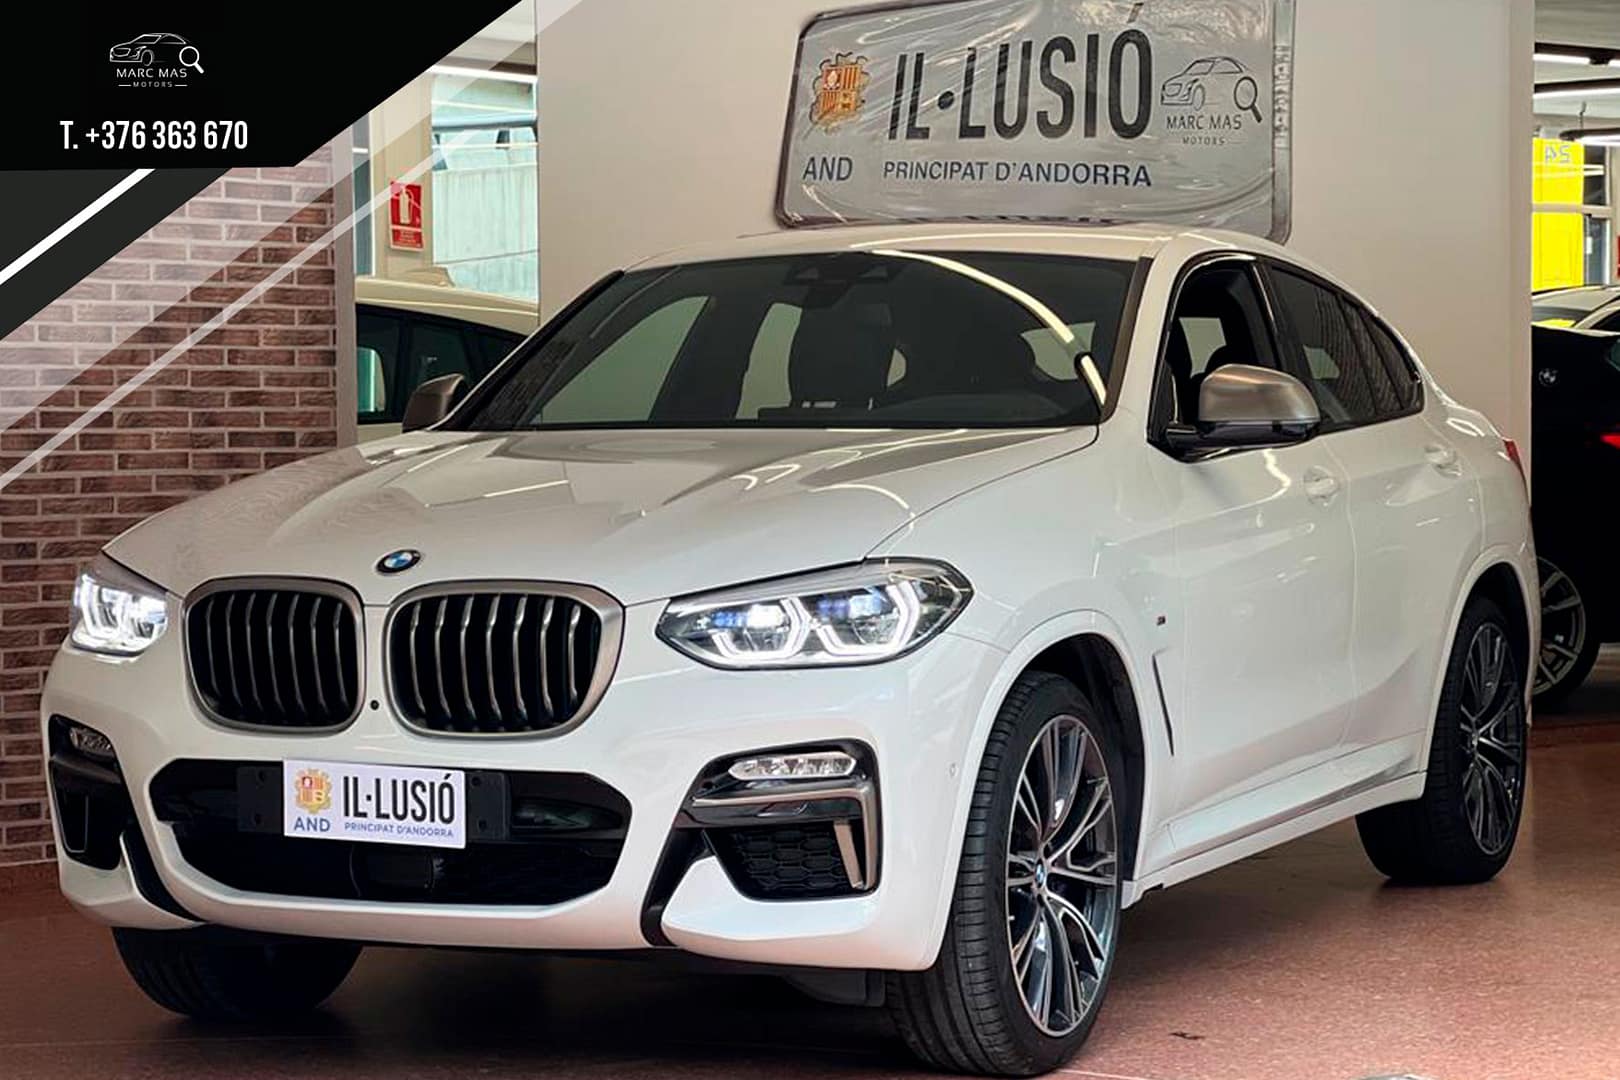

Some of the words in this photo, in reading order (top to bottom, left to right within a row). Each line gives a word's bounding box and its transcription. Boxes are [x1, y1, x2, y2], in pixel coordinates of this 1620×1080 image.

[1166, 115, 1204, 130] MARC
[1209, 114, 1243, 130] MAS
[1182, 136, 1226, 146] MOTORS
[802, 156, 853, 182] AND
[883, 161, 989, 181] PRINCIPAT
[995, 162, 1151, 187] D'ANDORRA
[293, 816, 331, 833] AND
[344, 821, 394, 834] PRINCIPAT
[398, 824, 455, 838] D'ANDORRA
